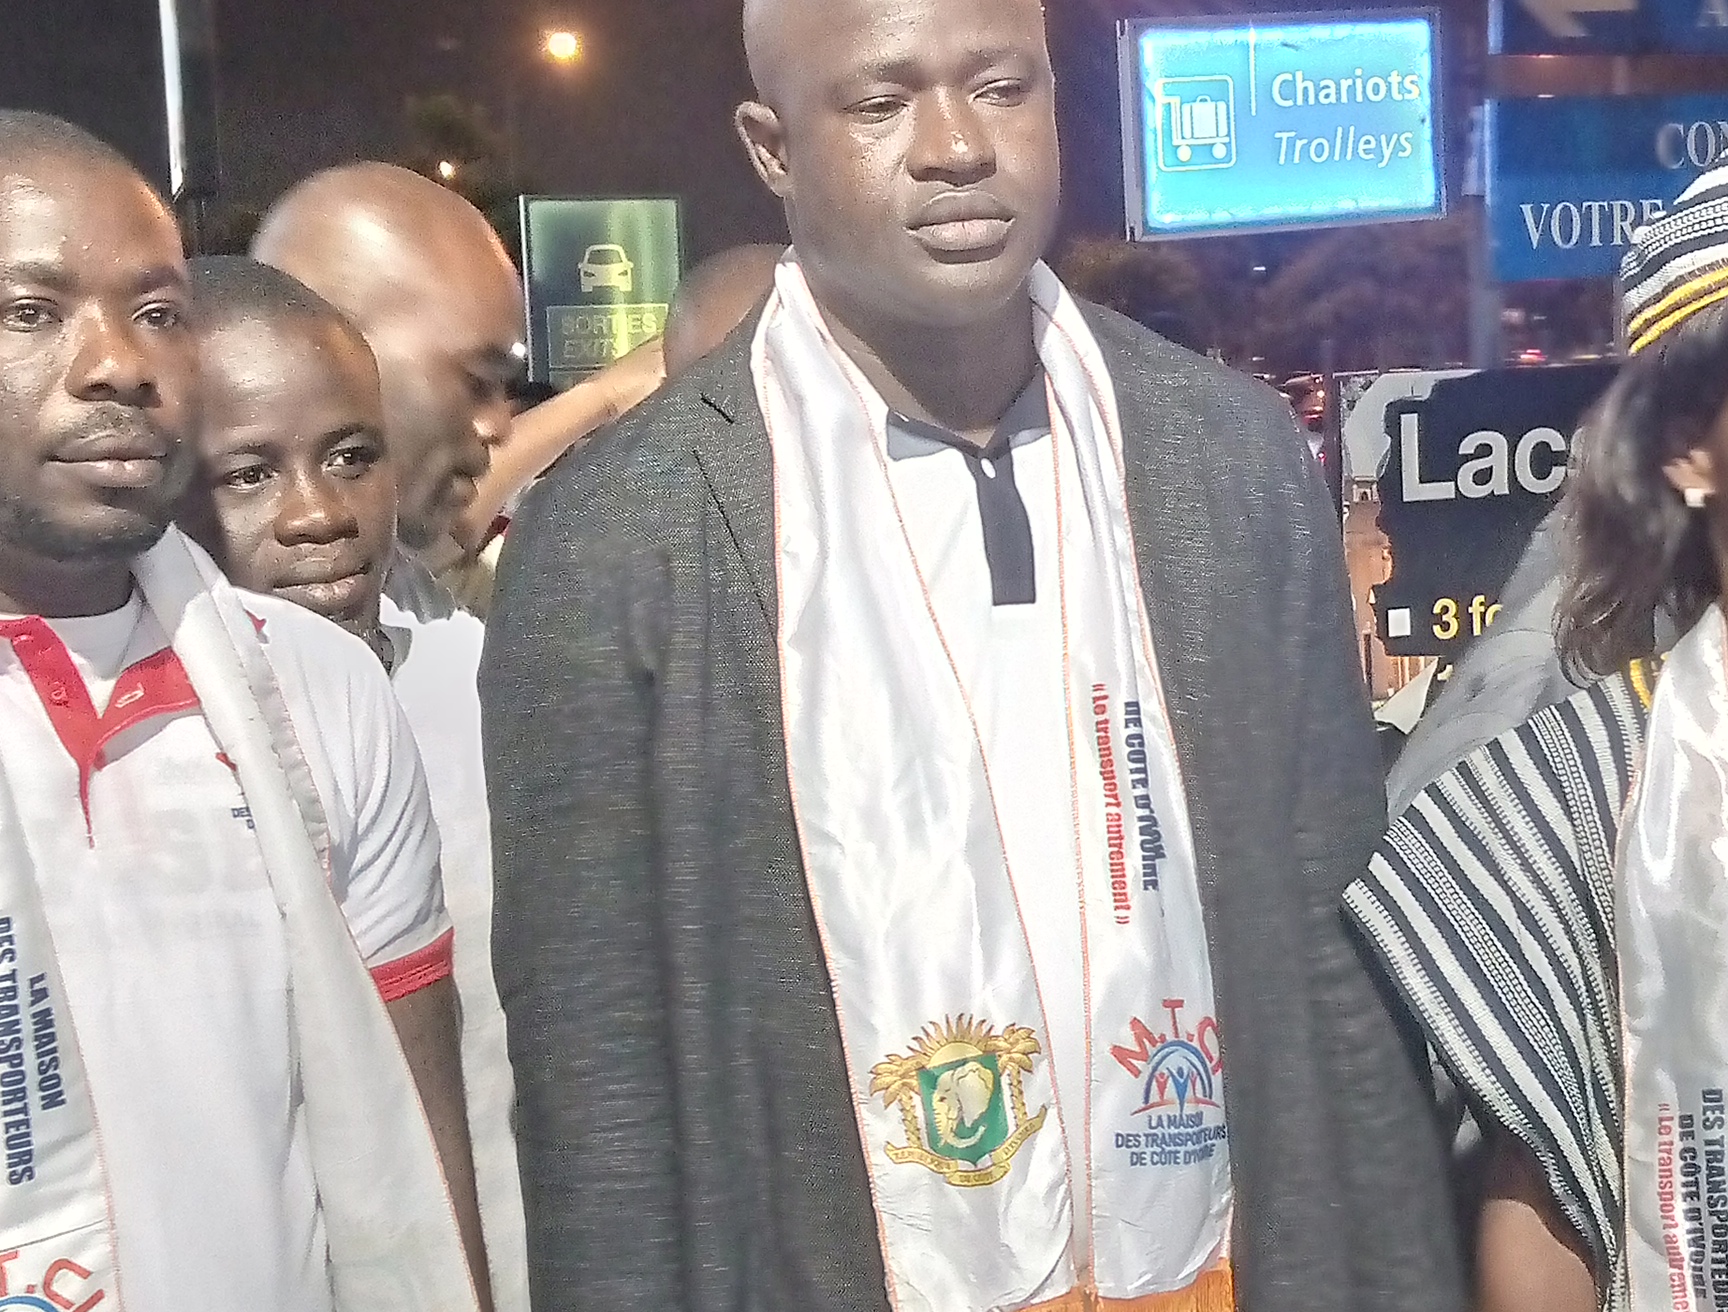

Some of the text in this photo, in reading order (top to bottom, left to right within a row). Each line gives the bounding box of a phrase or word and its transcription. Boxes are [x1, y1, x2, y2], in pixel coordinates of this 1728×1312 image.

[1272, 68, 1420, 109] Chariots
[1273, 125, 1414, 169] Trolleys
[1432, 597, 1460, 641] 3
[1095, 718, 1123, 809] transport
[1105, 812, 1132, 912] autrement
[28, 971, 67, 1111] LA MAISON
[1147, 1114, 1164, 1130] LA
[1657, 1115, 1675, 1137] Le
[1678, 1113, 1695, 1142] DE
[1702, 1089, 1725, 1131] DES
[1114, 1132, 1142, 1149] DES
[1130, 1150, 1148, 1167] DE
[1657, 1138, 1679, 1231] transport
